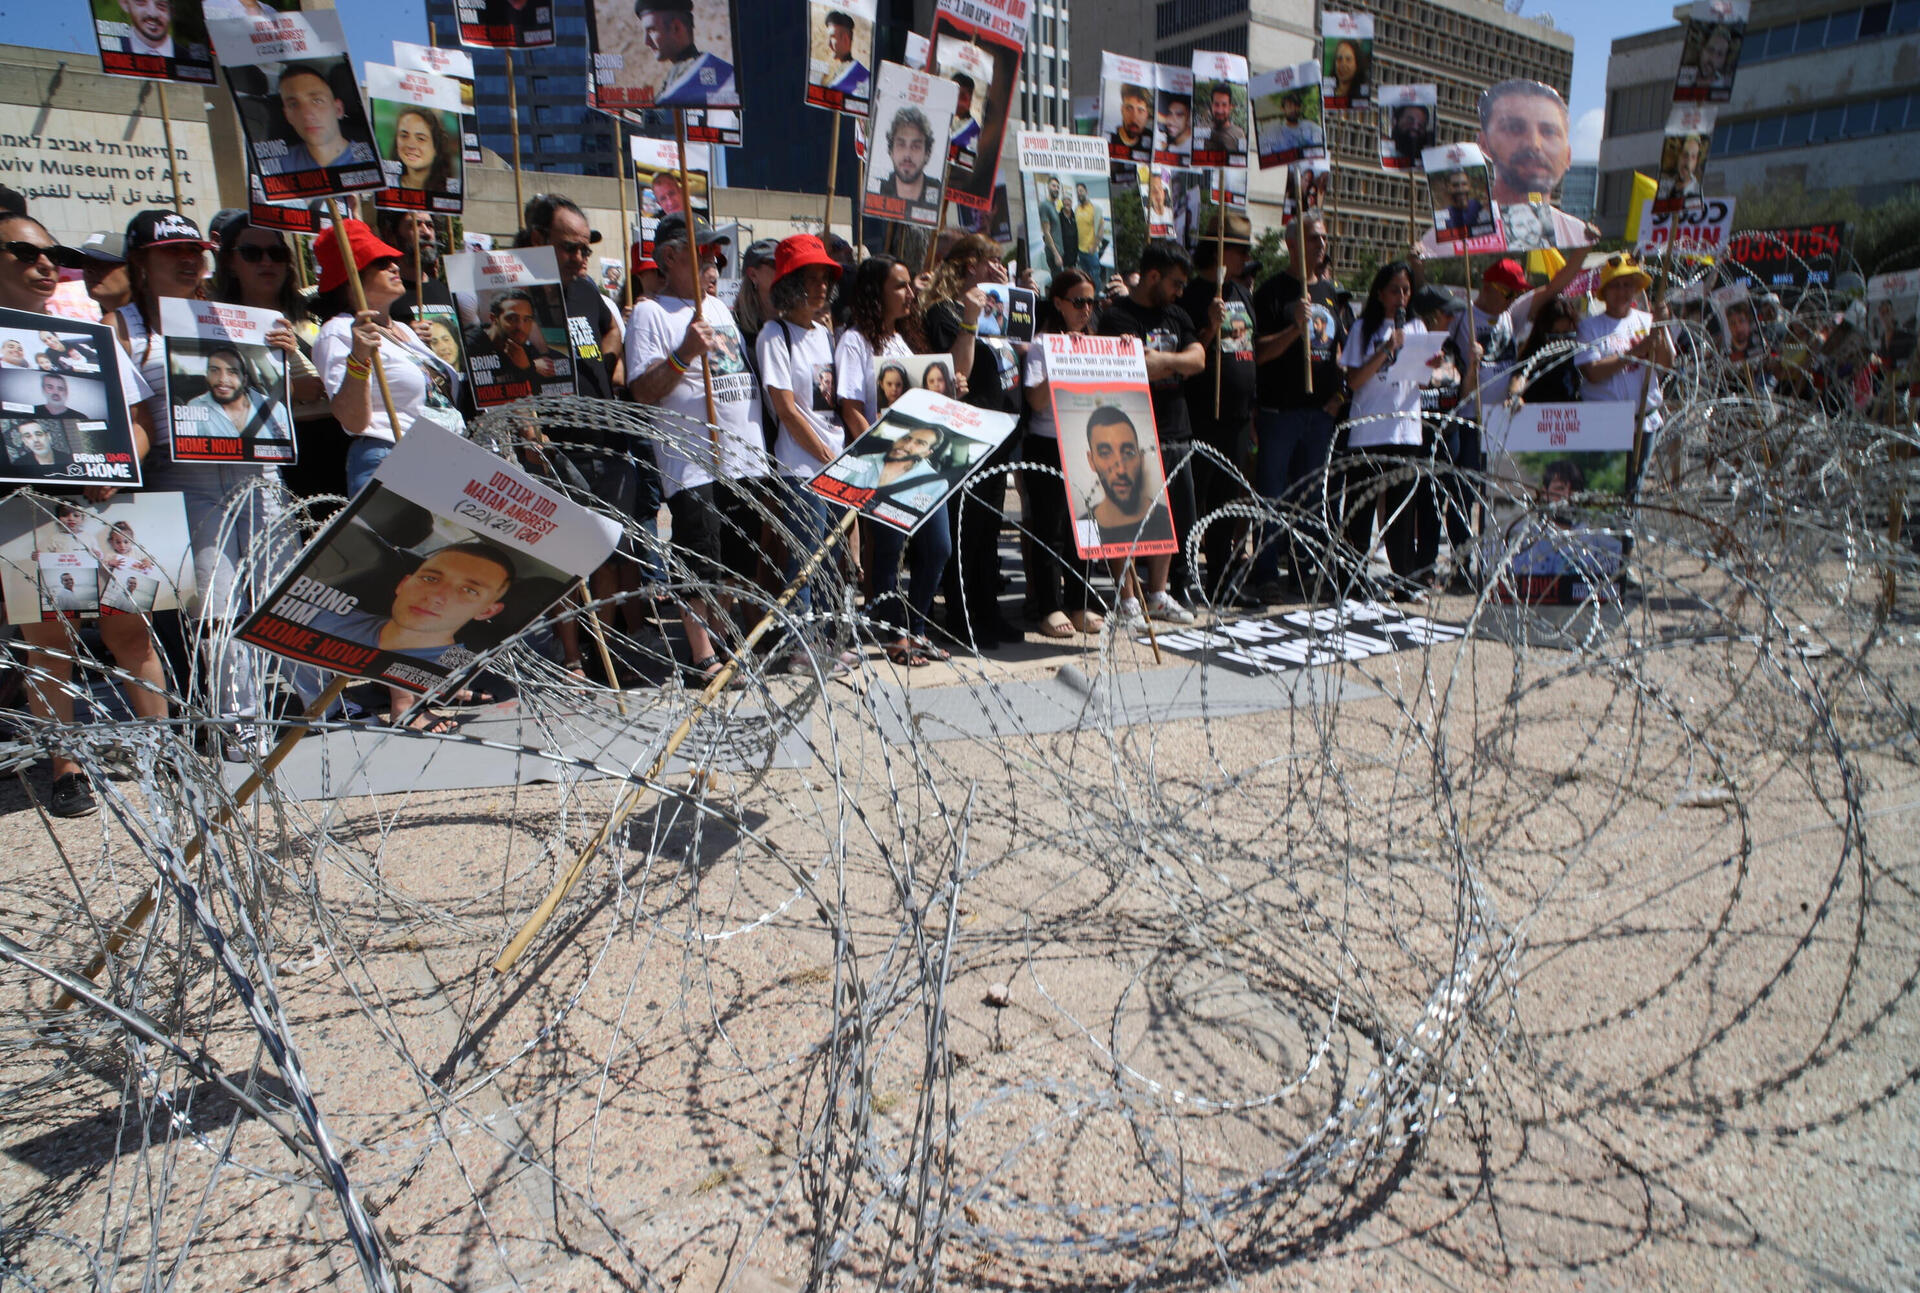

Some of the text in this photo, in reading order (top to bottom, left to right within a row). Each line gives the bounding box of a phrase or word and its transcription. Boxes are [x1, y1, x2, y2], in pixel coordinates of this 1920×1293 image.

[47, 137, 92, 156] אביב
[96, 139, 122, 158] תל
[40, 159, 130, 179] Museum
[134, 167, 155, 181] of
[76, 184, 116, 205] أبيب
[122, 187, 142, 205] تل
[1049, 336, 1065, 353] 22
[470, 354, 501, 371] BRING
[473, 369, 494, 386] HIM
[713, 376, 739, 391] BRING
[718, 390, 743, 403] HOME
[173, 404, 210, 422] BRING
[175, 420, 198, 437] HIM
[1537, 421, 1553, 433] GUY
[176, 438, 209, 455] HOME
[211, 437, 244, 455] NOW!
[72, 452, 133, 464] BRING OMRI
[85, 463, 133, 479] HOME
[462, 478, 560, 536] MATAN ANGREST
[530, 495, 559, 519] מתן
[285, 574, 361, 618] BRING
[268, 595, 321, 627] HIM
[251, 615, 382, 669] HOME NOW!
